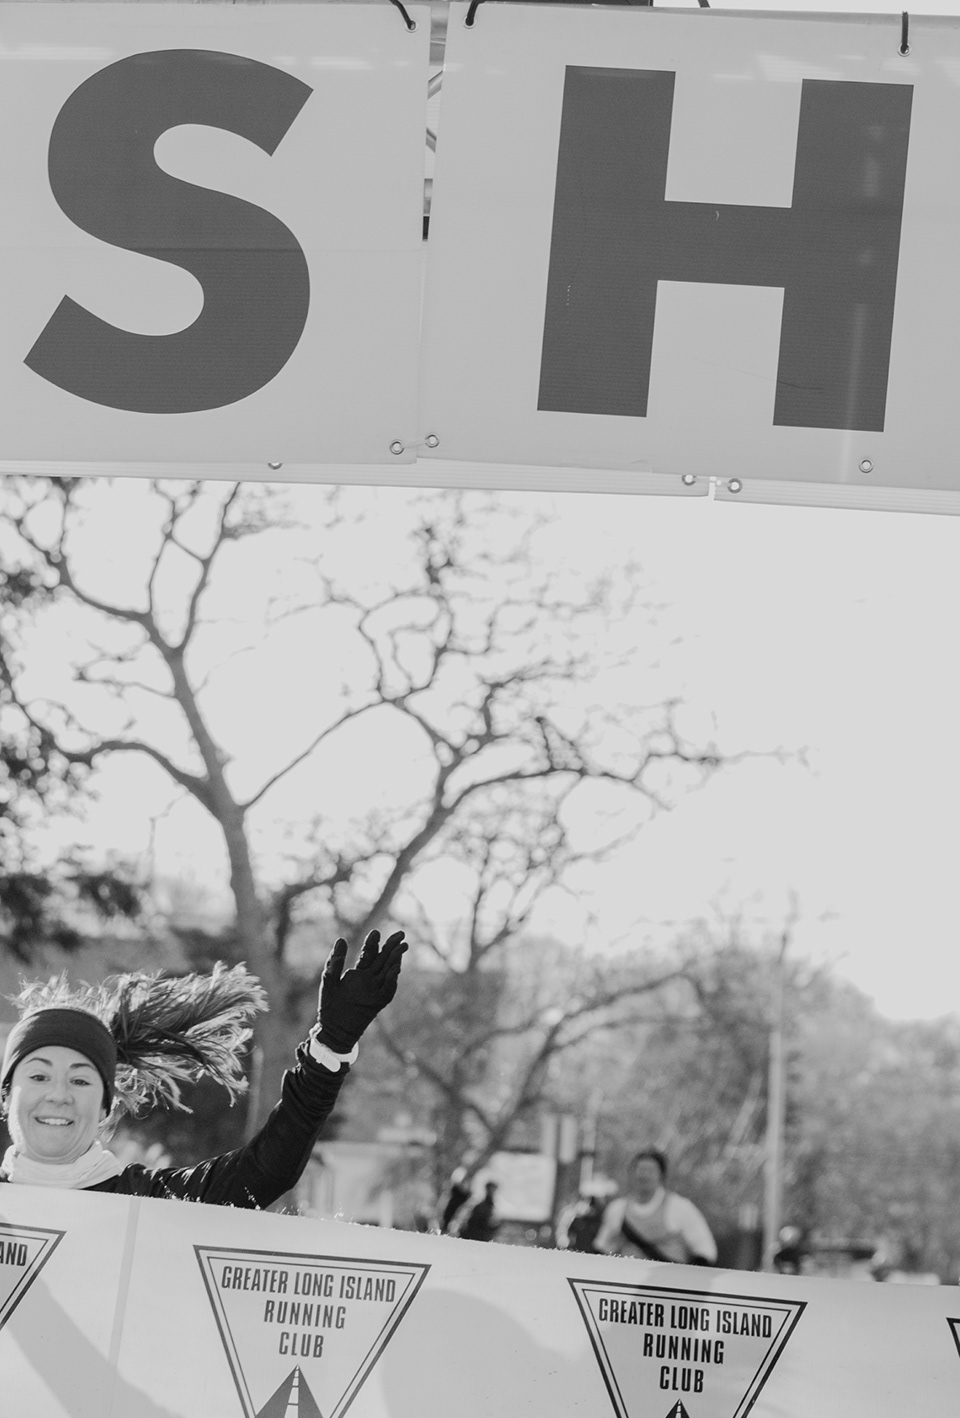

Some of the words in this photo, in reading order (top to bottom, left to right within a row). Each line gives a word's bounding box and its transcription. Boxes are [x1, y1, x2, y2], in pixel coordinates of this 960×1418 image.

[220, 1265, 289, 1294] GREATER
[293, 1271, 335, 1298] LONG
[339, 1275, 396, 1303] ISLAND
[263, 1299, 347, 1330] RUNNING
[598, 1297, 665, 1328] GREATER
[669, 1304, 710, 1332] LONG
[716, 1309, 773, 1339] ISLAND
[278, 1331, 325, 1359] CLUB
[642, 1332, 725, 1365] RUNNING
[658, 1365, 705, 1394] CLUB
